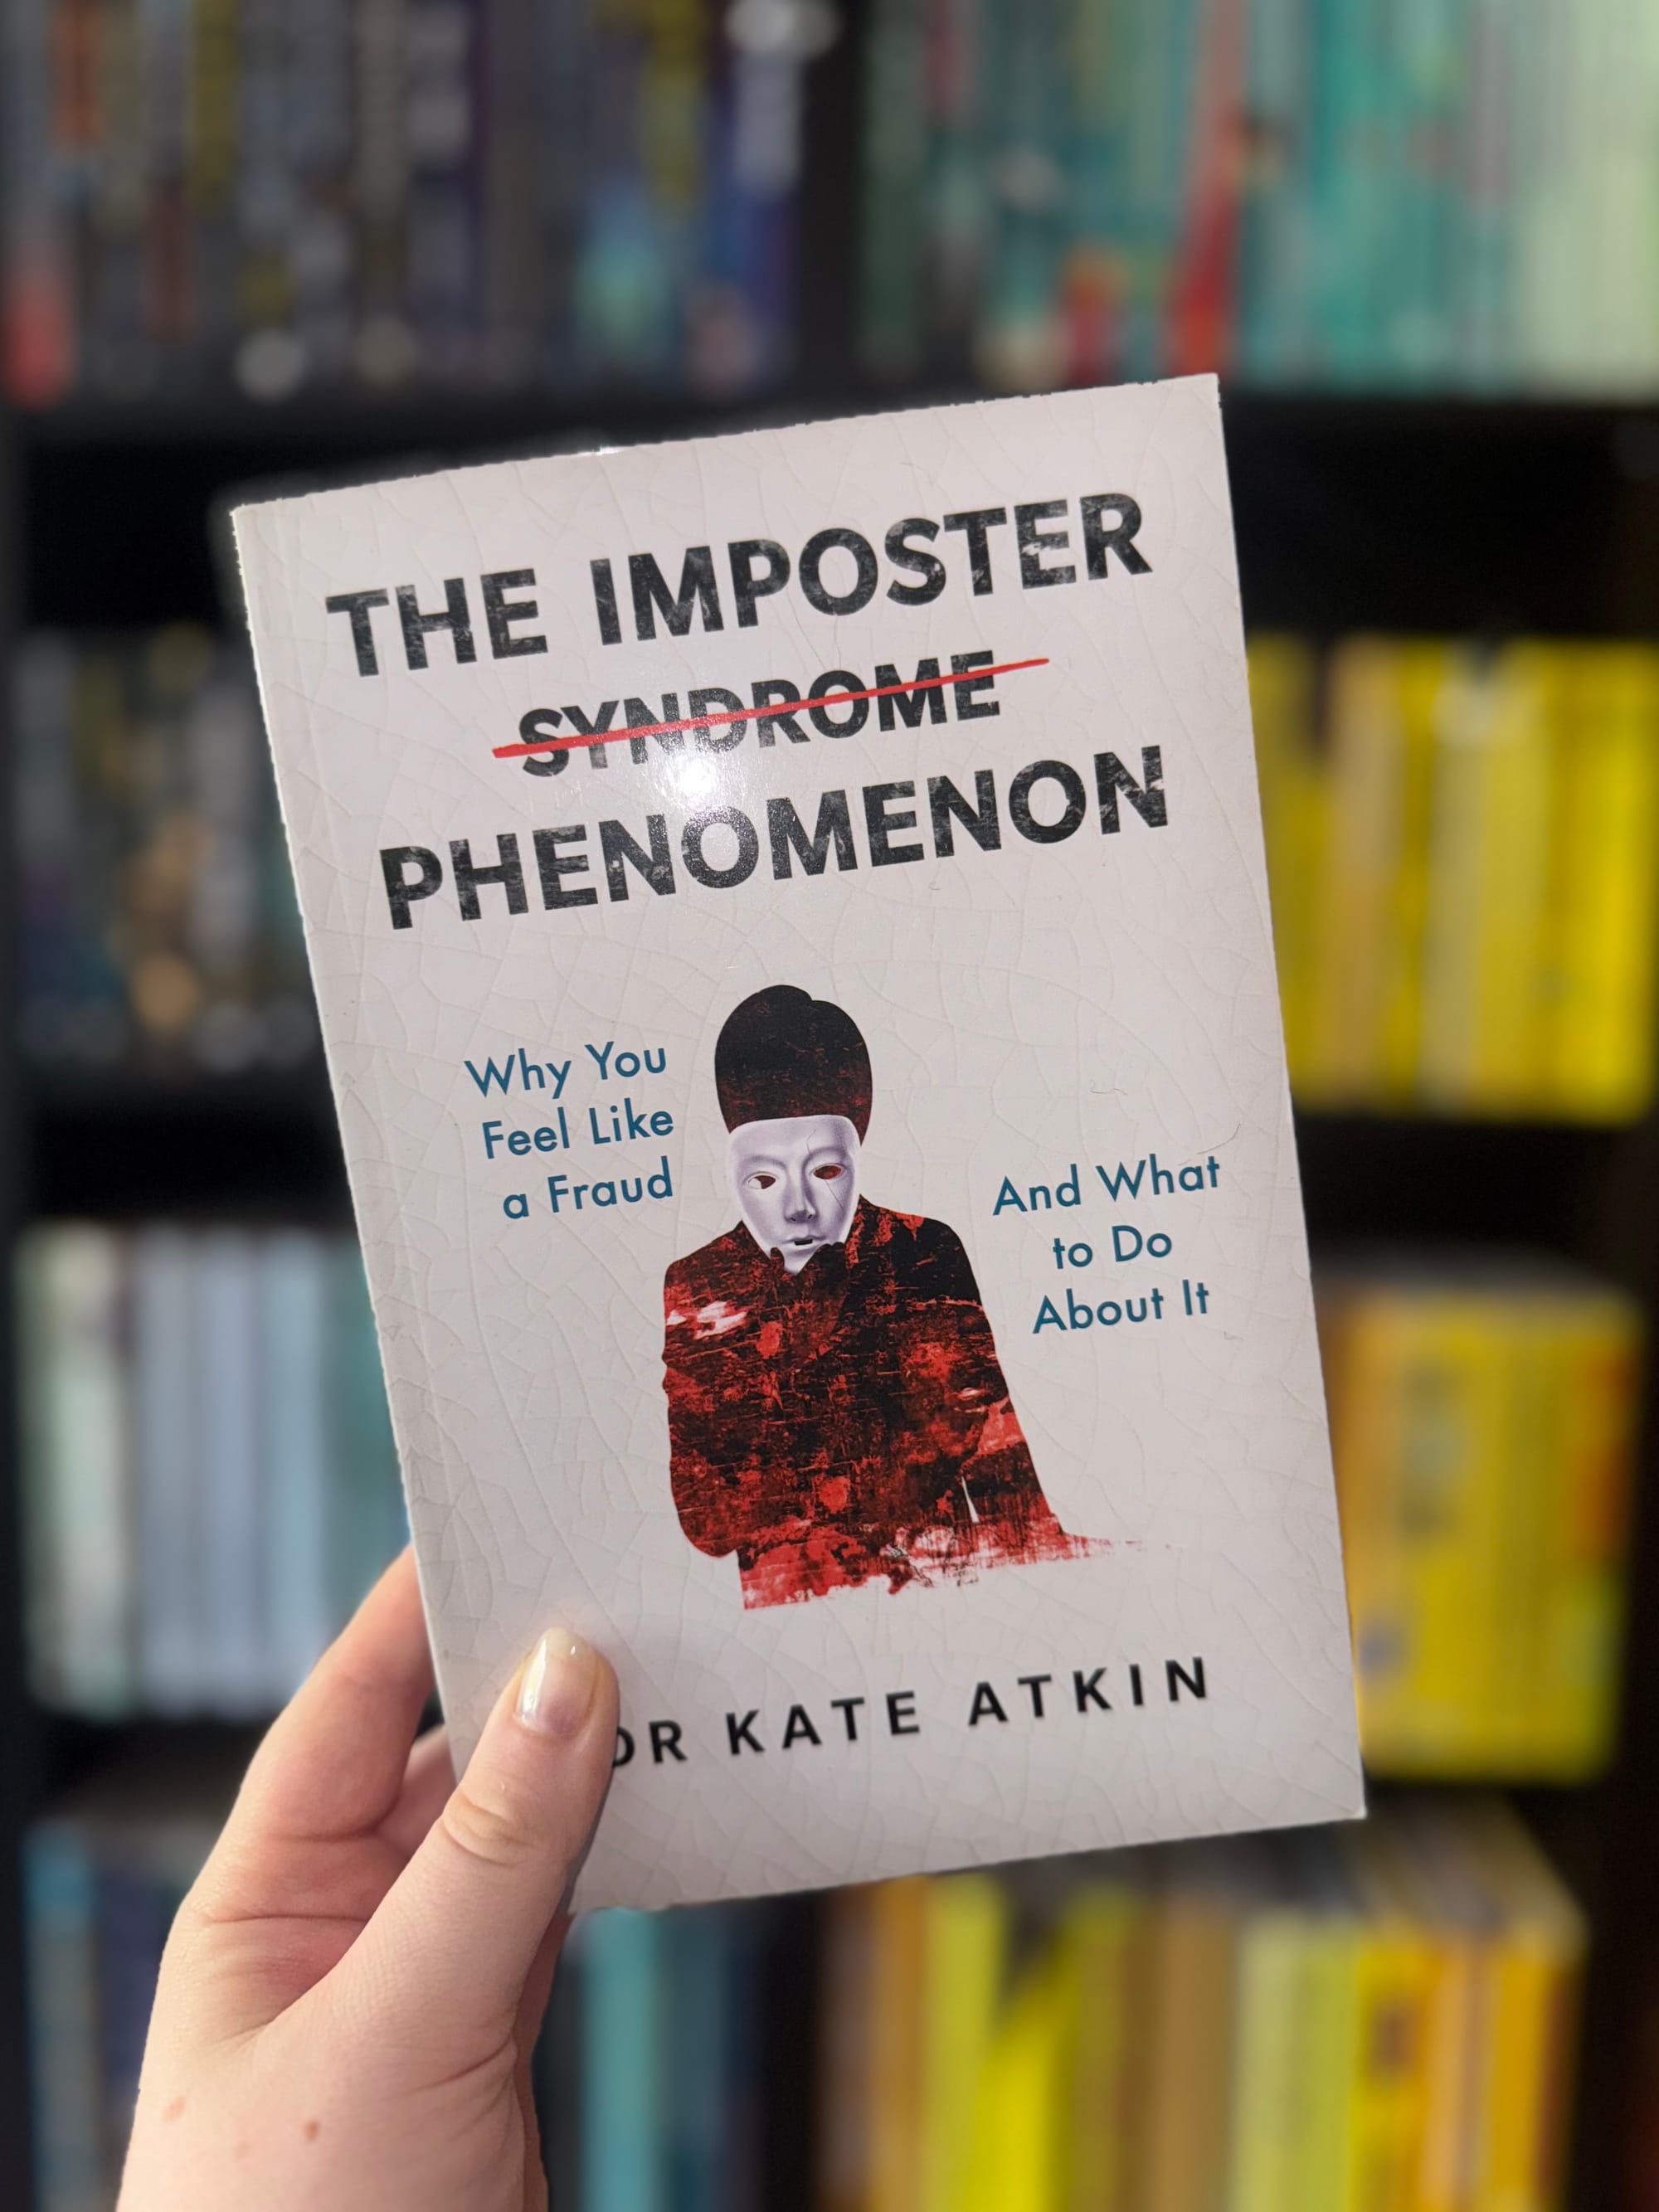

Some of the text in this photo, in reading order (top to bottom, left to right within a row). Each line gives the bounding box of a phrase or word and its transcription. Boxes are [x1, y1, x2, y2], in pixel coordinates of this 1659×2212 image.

[325, 493, 1154, 677] THE IMPOSTER
[518, 649, 1000, 777] SYNDROME
[379, 745, 1168, 930] PHENOMENON
[464, 1041, 666, 1100] Why You
[482, 1097, 674, 1159] Feel Like
[503, 1155, 674, 1220] a Fraud
[992, 1153, 1220, 1216] And What
[1052, 1225, 1172, 1270] to Do
[1032, 1279, 1209, 1334] About It
[725, 1690, 920, 1757] KATE
[968, 1657, 1207, 1727] ATKIN
